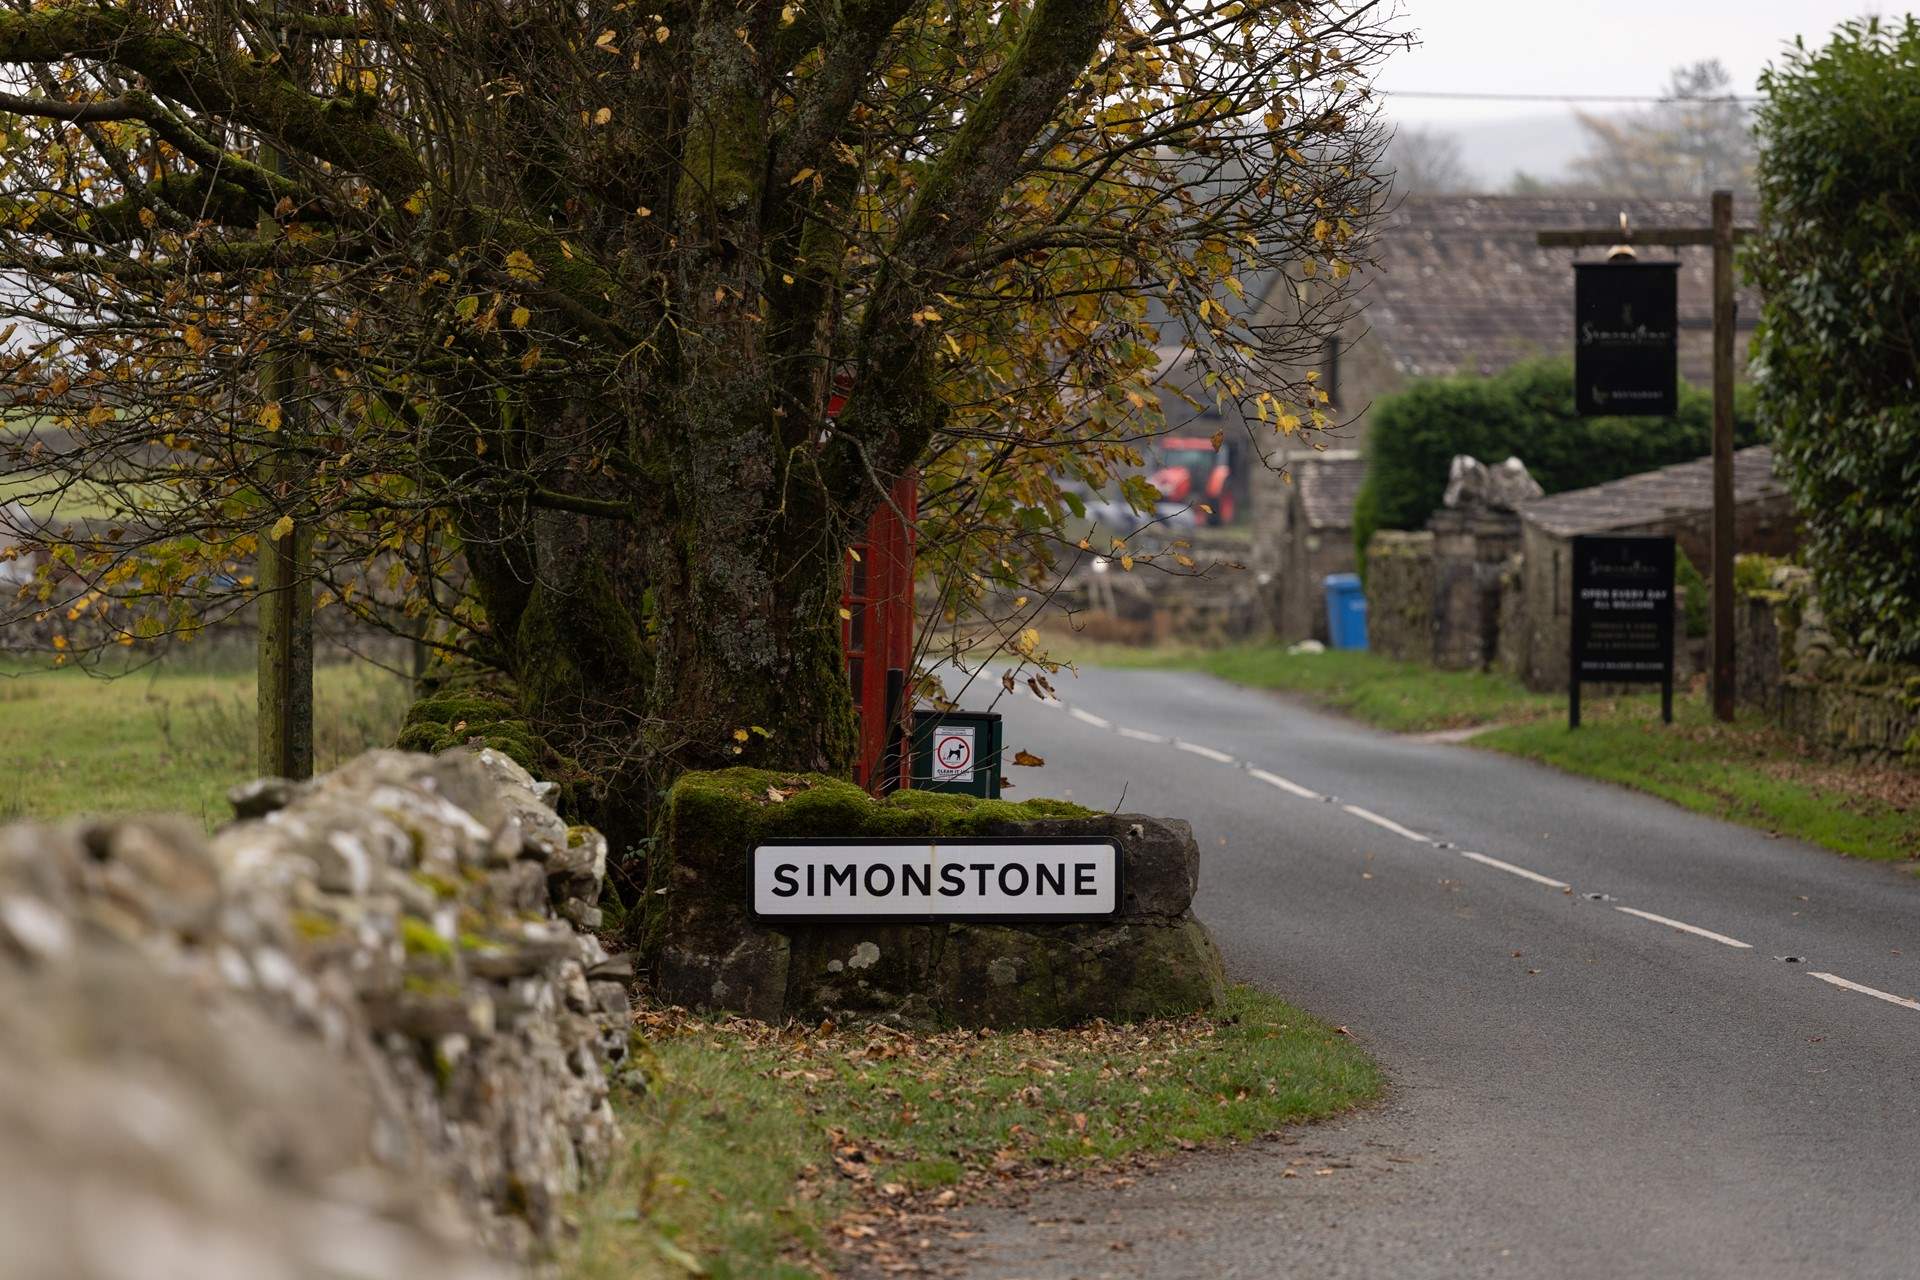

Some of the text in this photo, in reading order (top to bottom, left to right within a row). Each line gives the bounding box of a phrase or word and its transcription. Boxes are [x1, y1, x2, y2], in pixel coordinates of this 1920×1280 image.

[1582, 589, 1667, 599] OPEN EVERY DAY
[1612, 601, 1654, 609] WELCOME
[771, 863, 1098, 897] SIMONSTONE
